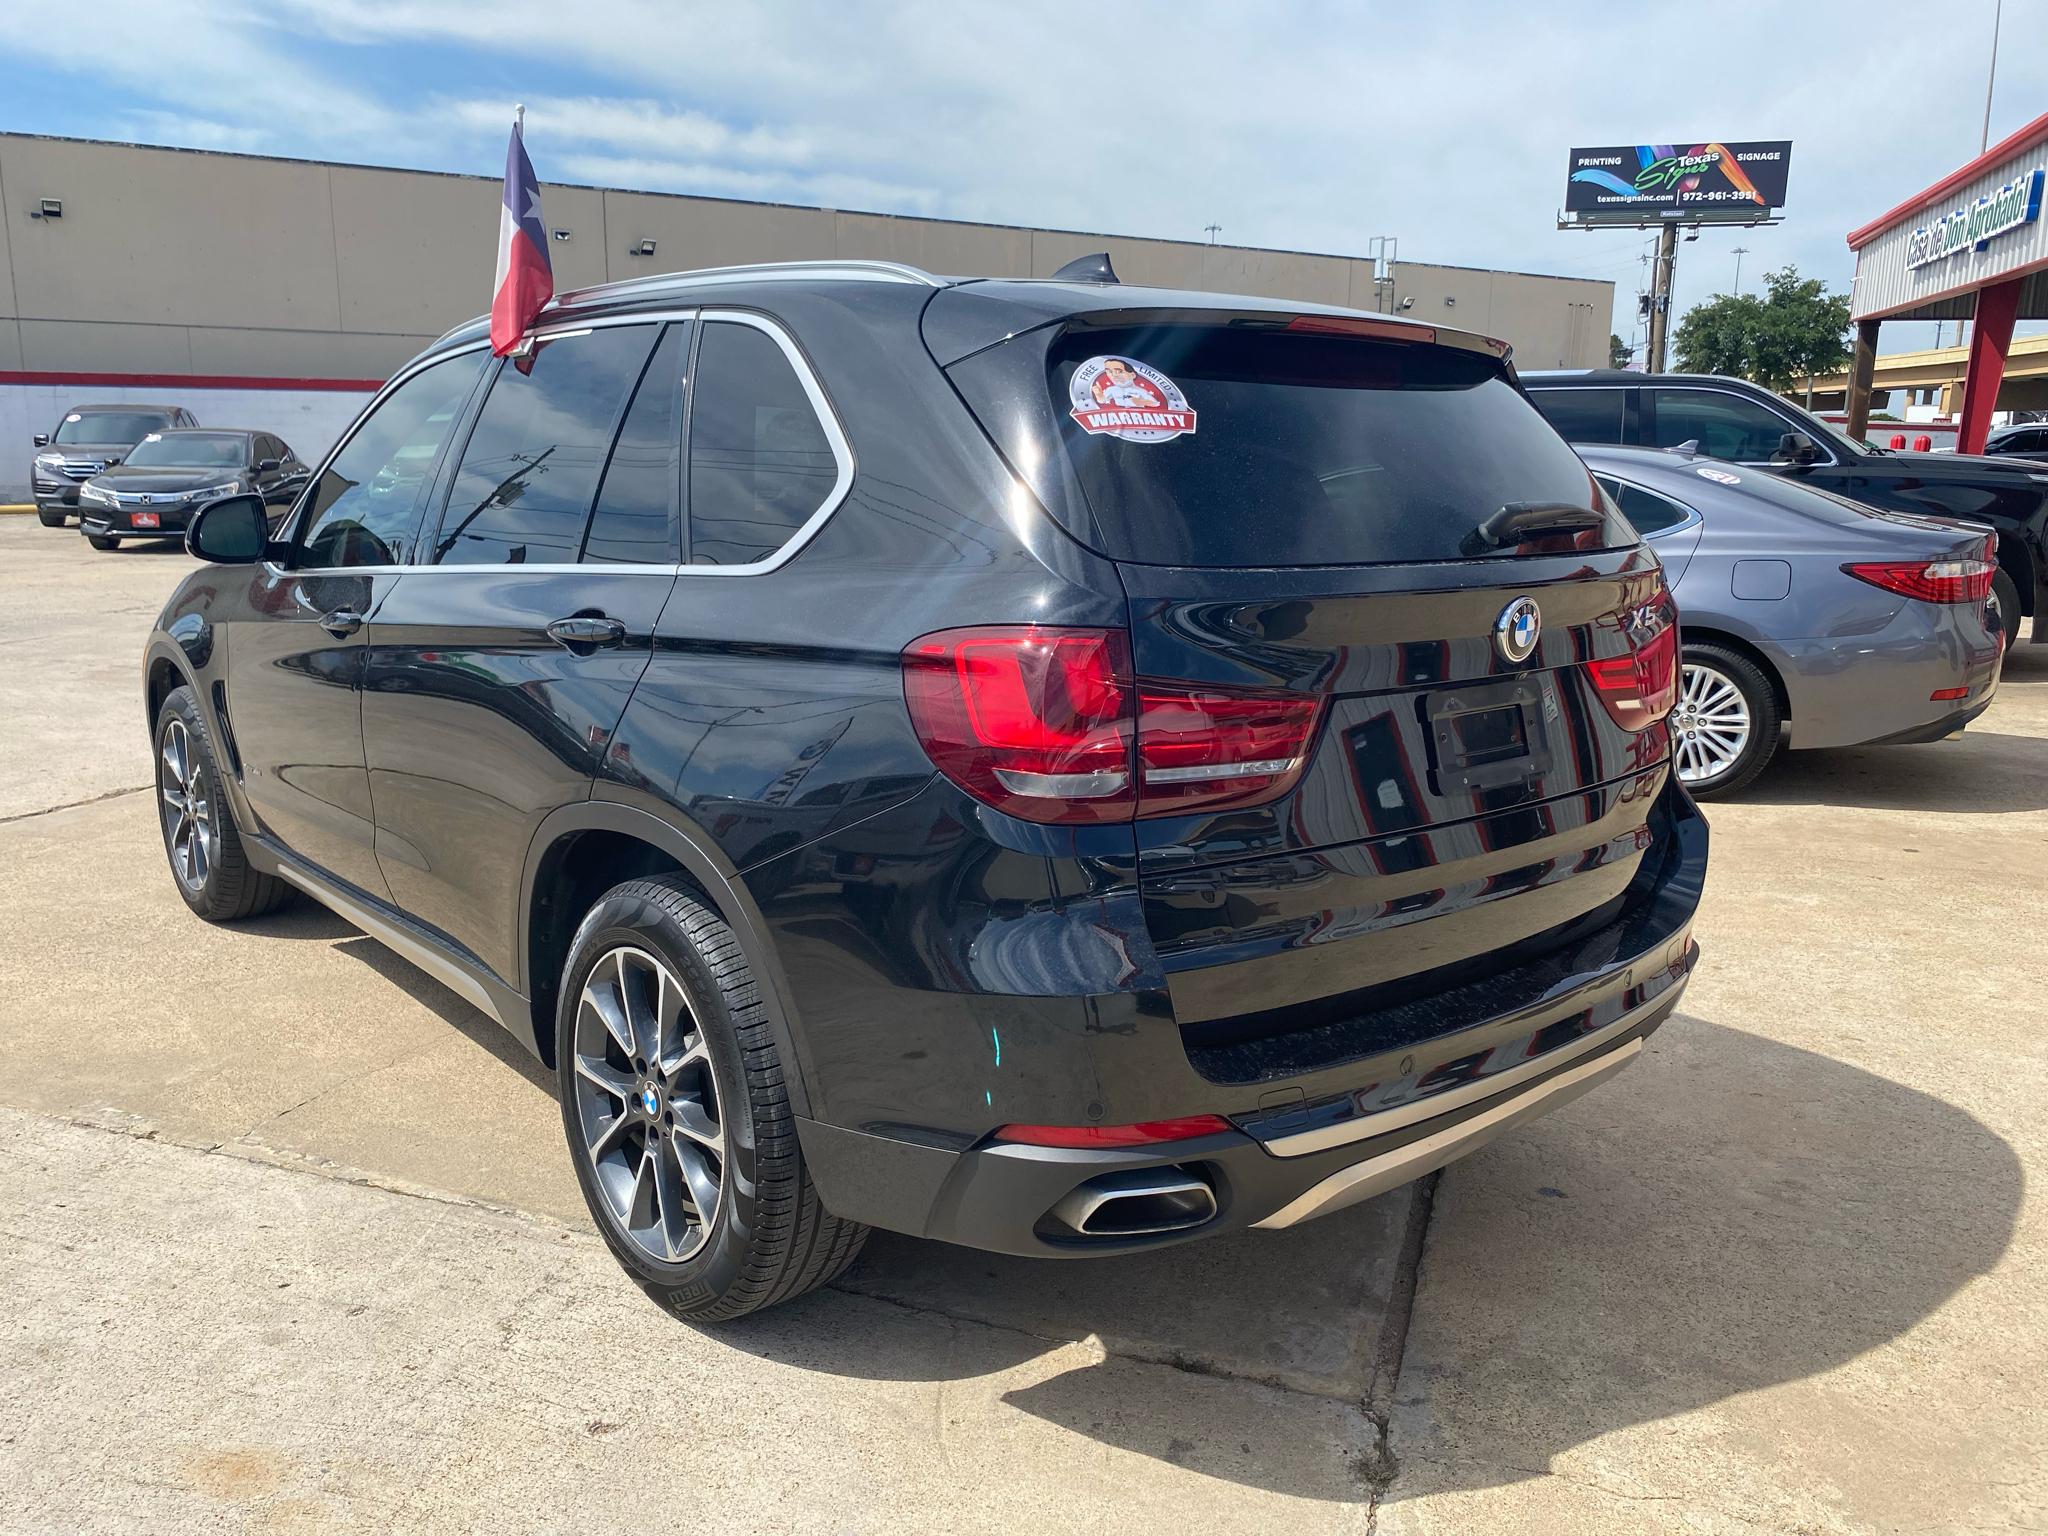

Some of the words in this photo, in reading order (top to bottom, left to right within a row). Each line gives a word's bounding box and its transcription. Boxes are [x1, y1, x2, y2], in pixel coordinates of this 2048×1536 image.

[1578, 157, 1622, 166] PRINTING
[1678, 152, 1719, 167] Texas
[1737, 152, 1781, 161] SIGNAGE
[1634, 158, 1709, 190] Signs
[1597, 194, 1674, 204] texassignsinc.com
[1682, 191, 1756, 201] 972-961-3951
[1906, 234, 1929, 268] Casa
[1929, 222, 1943, 258] de
[1943, 216, 1966, 252] Don
[1965, 176, 2031, 249] Aprobado!
[1080, 364, 1099, 382] FREE
[1139, 366, 1172, 391] LIMITED
[1086, 412, 1186, 428] WARRANTY
[1626, 603, 1657, 632] X5
